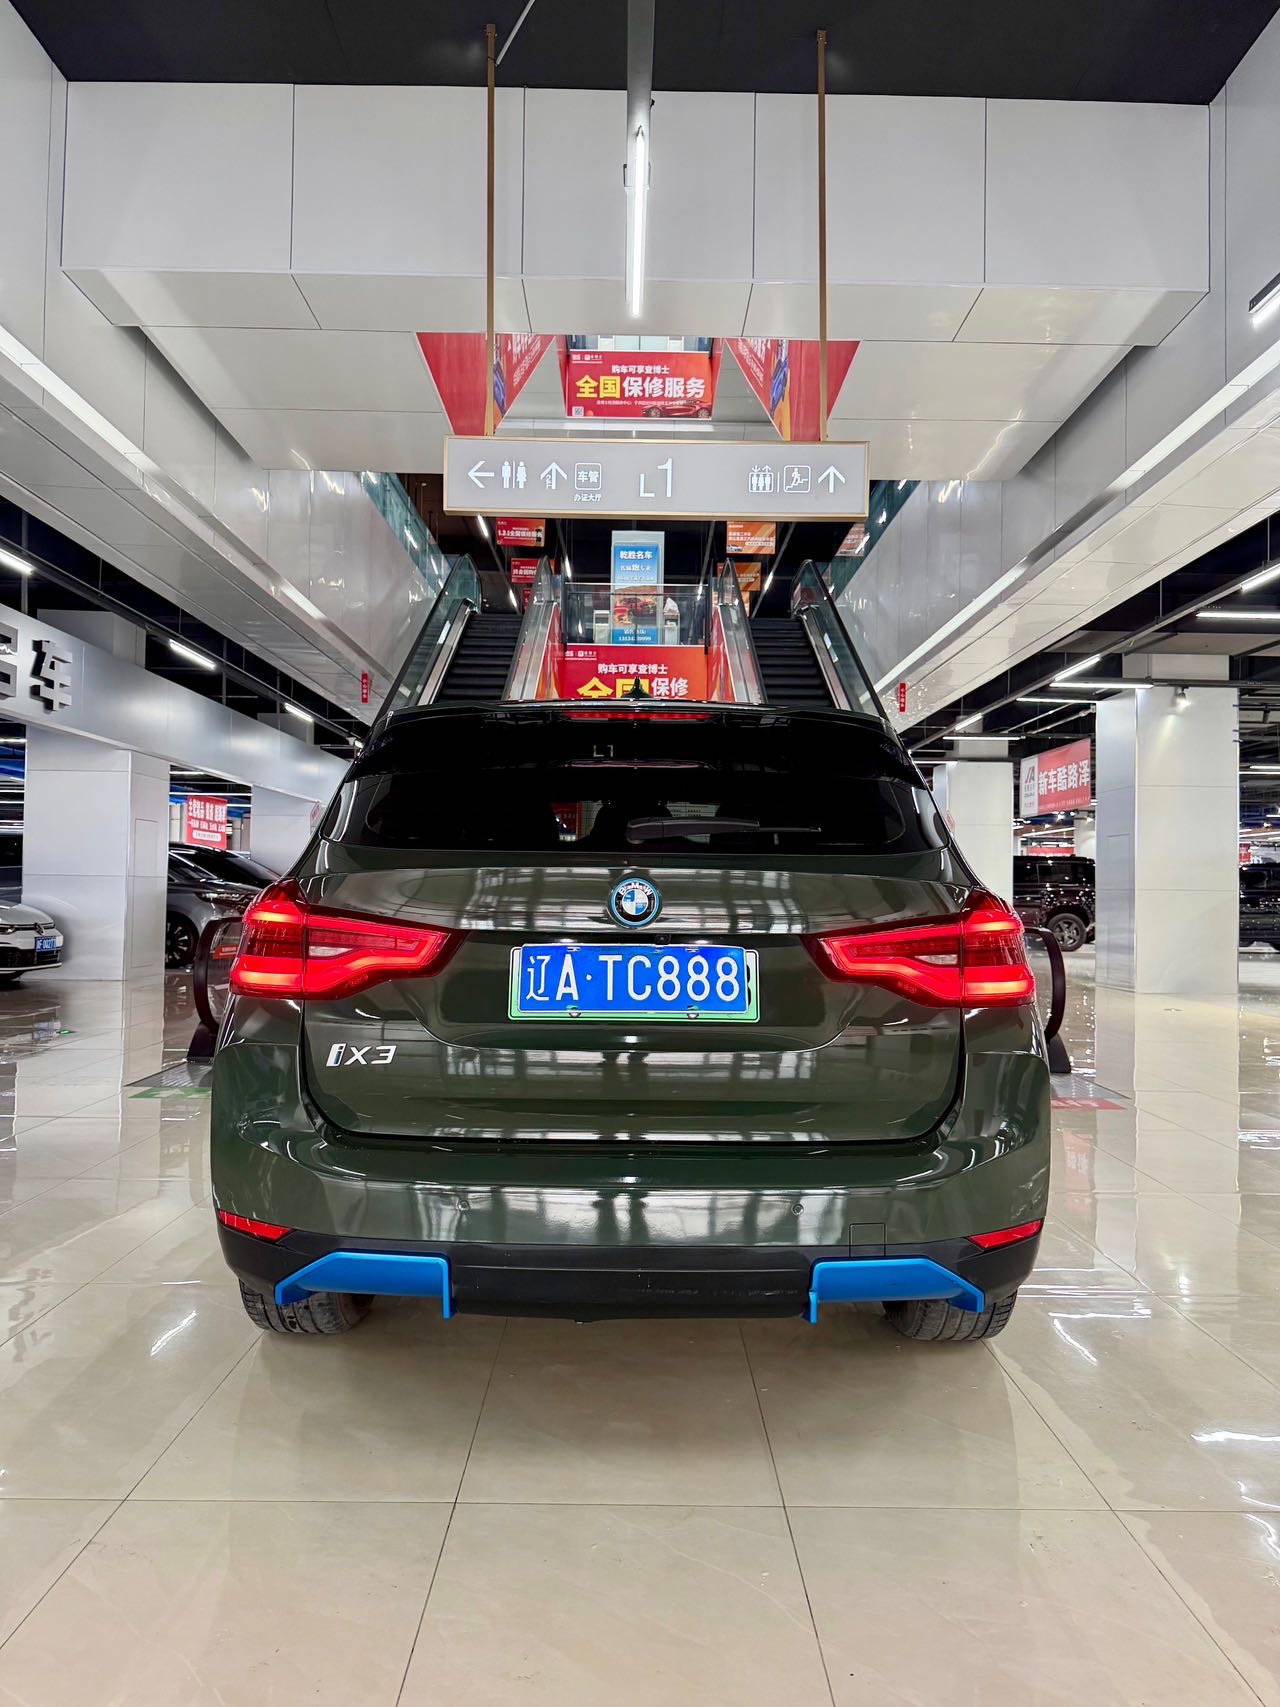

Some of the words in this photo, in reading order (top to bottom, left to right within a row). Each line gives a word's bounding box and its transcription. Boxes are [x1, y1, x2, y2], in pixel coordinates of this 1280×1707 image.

[611, 364, 670, 374] 购车可享查博士
[575, 374, 706, 399] 全国保修服务
[577, 470, 600, 483] 车管
[639, 458, 673, 498] L1
[574, 493, 602, 502] 办证大厅
[597, 663, 669, 675] 购车可享查博士
[1038, 759, 1091, 796] 新车酷路泽
[618, 881, 654, 896] BMW
